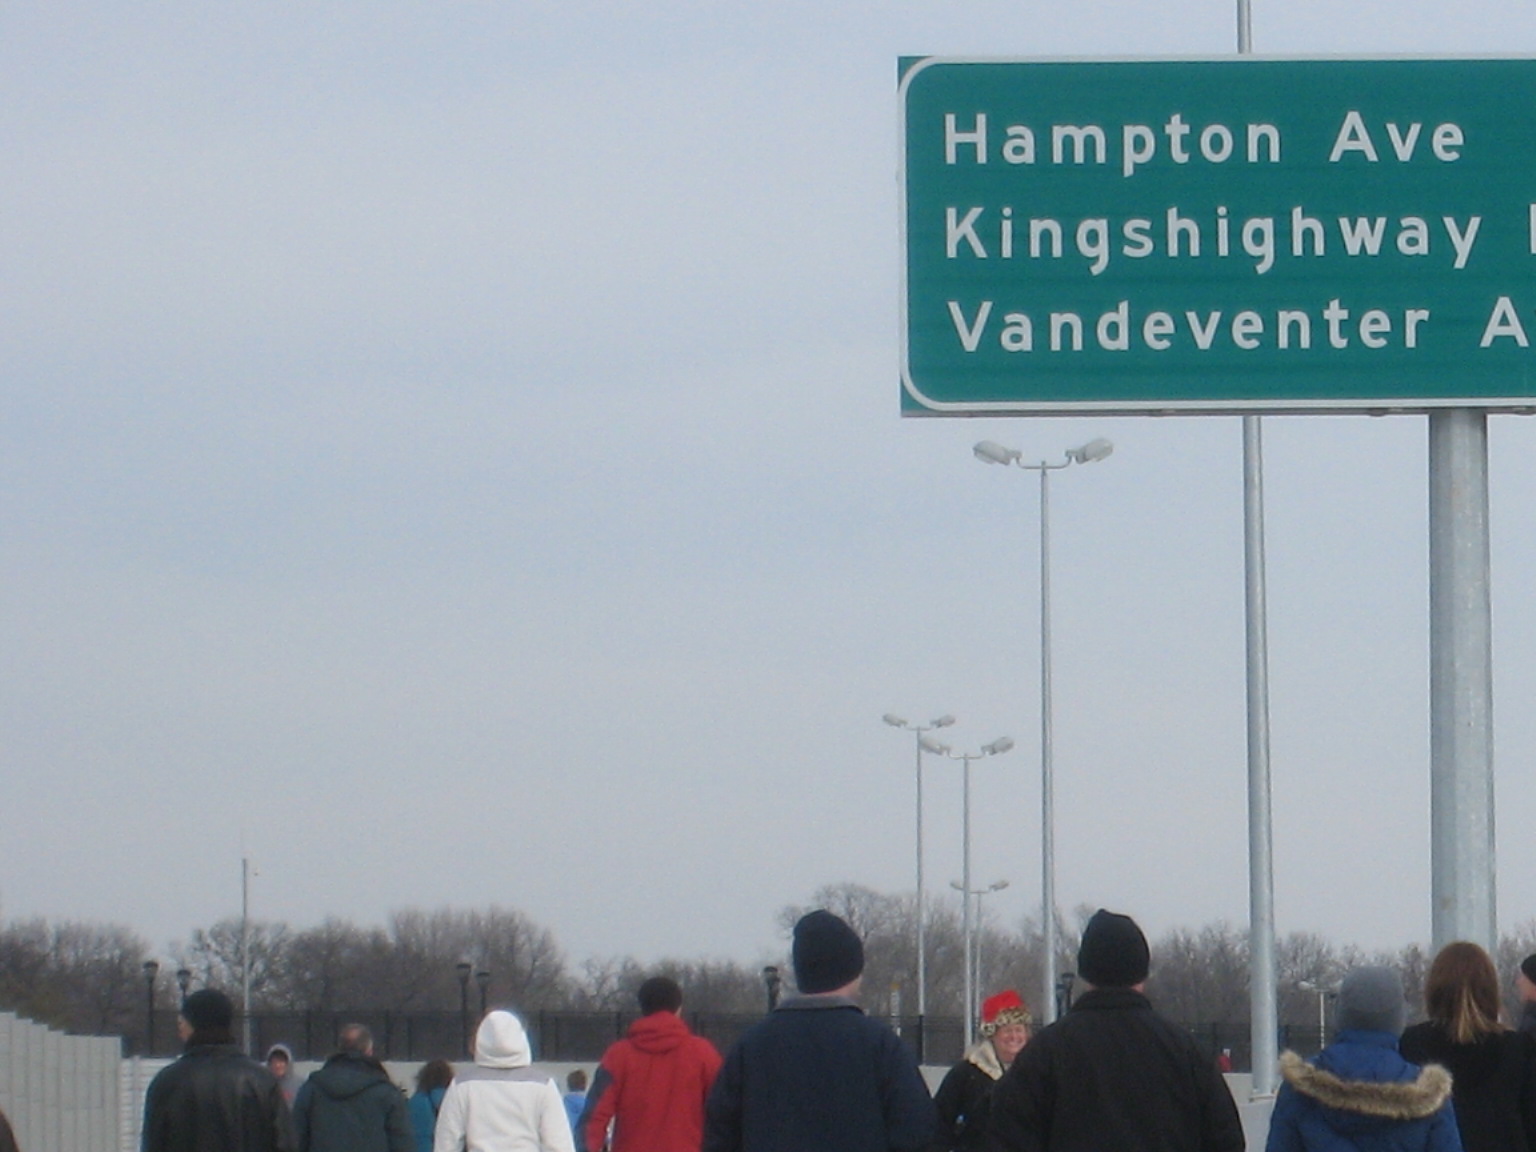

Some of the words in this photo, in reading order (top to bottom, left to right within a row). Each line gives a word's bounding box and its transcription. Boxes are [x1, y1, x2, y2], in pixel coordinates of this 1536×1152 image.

[944, 112, 1281, 178] Hampton
[1329, 110, 1465, 163] Ave
[945, 205, 1483, 276] Kingshighway
[947, 298, 1431, 352] Vandeventer
